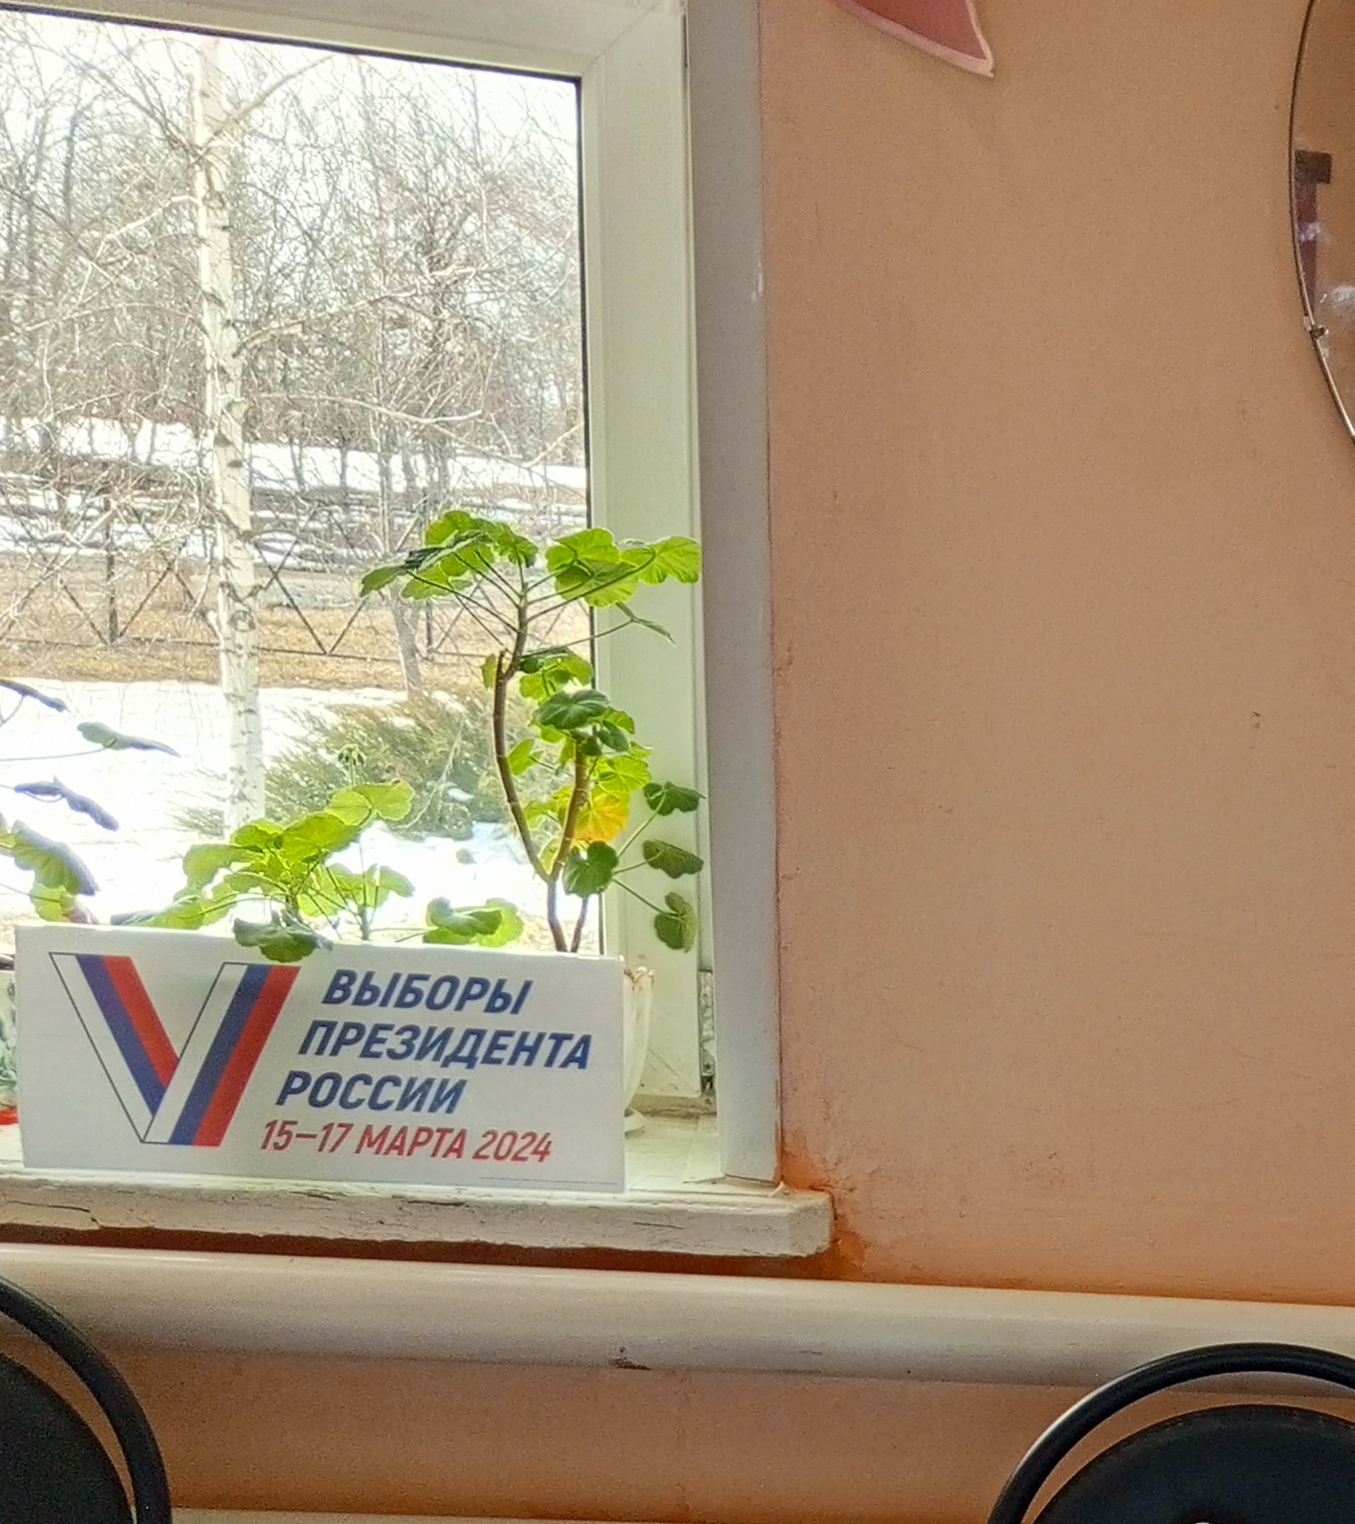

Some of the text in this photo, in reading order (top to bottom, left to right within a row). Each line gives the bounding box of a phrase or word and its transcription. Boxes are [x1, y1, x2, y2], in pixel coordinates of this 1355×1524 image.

[322, 969, 534, 1015] ВЫБОРЫ
[299, 1020, 593, 1071] ПРЕЗИДЕНТА
[276, 1071, 468, 1115] РОССИИ
[356, 1125, 465, 1160] МАРТА
[473, 1130, 554, 1164] 2024
